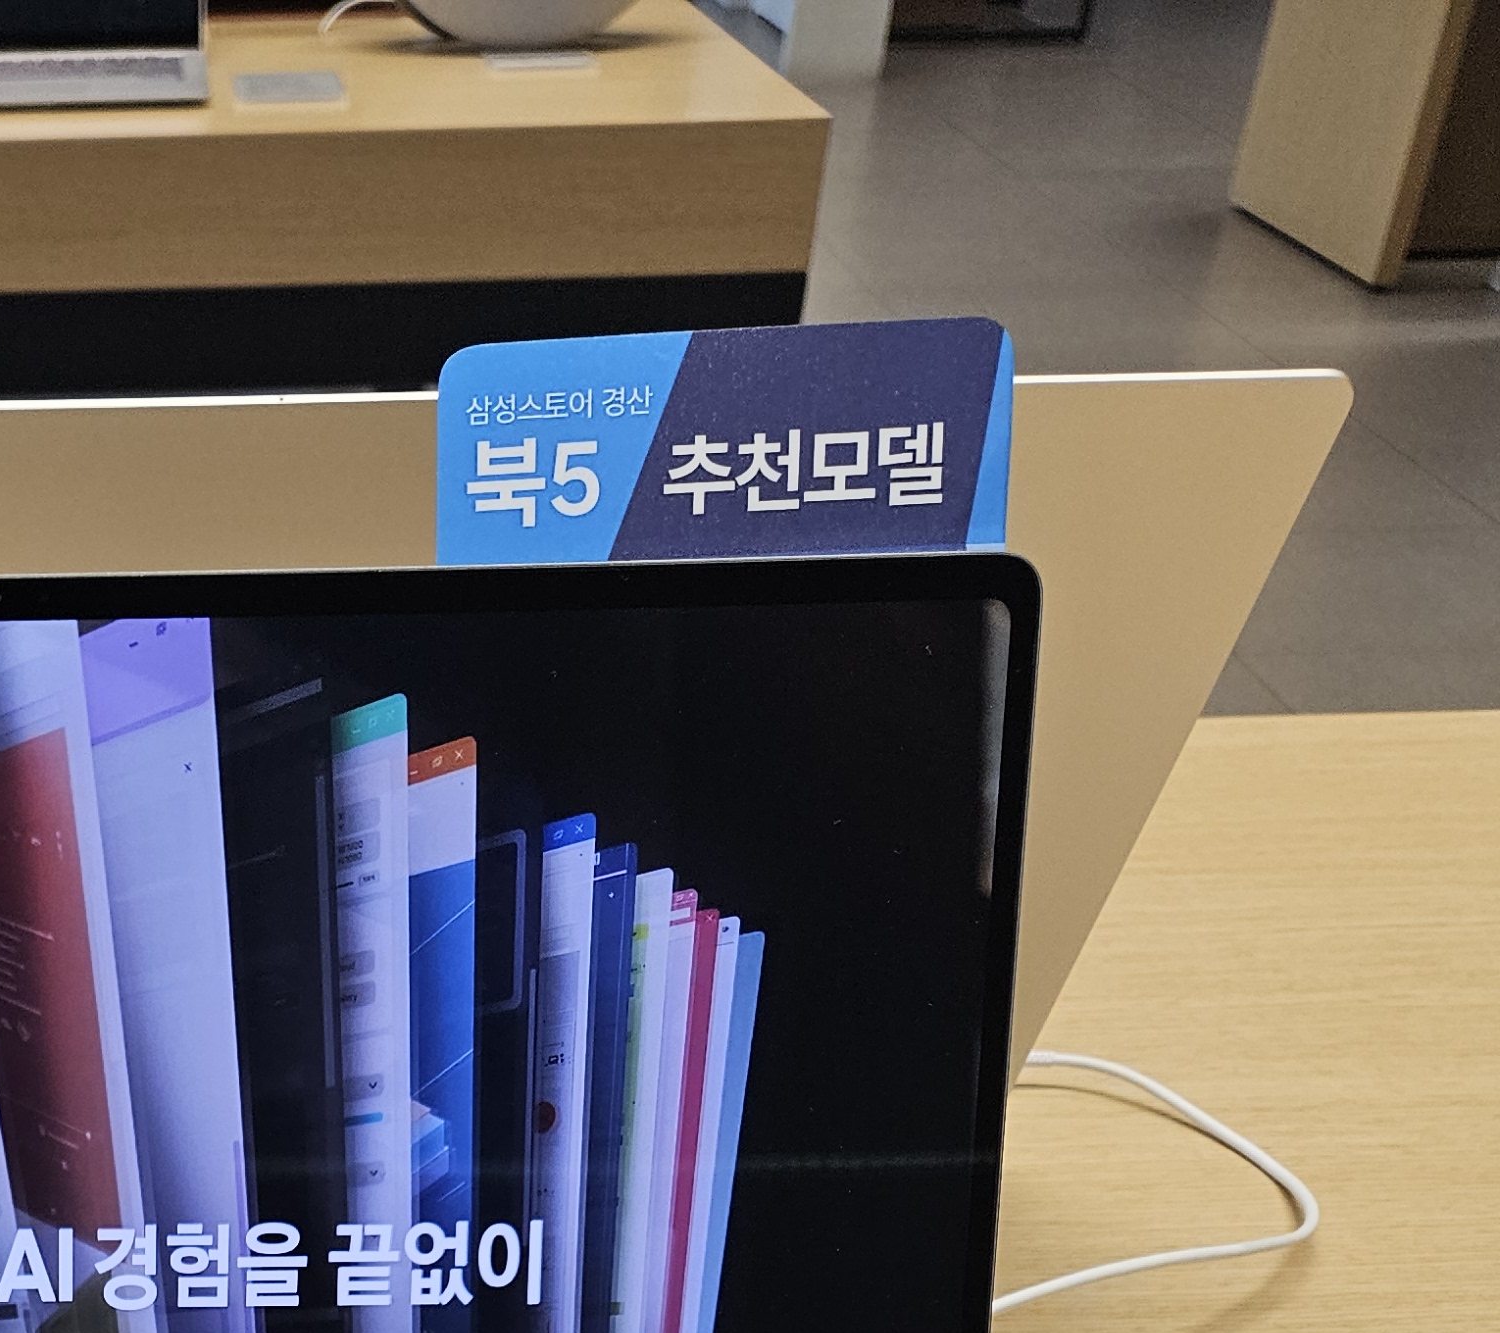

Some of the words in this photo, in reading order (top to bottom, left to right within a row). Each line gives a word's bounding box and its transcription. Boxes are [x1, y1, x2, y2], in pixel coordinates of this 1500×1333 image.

[466, 390, 593, 425] 삼성스토어
[602, 385, 653, 418] 경산
[466, 437, 600, 527] 북5
[664, 422, 945, 515] 추천모델
[94, 1222, 307, 1309] 경험을
[327, 1219, 544, 1308] 끝없이
